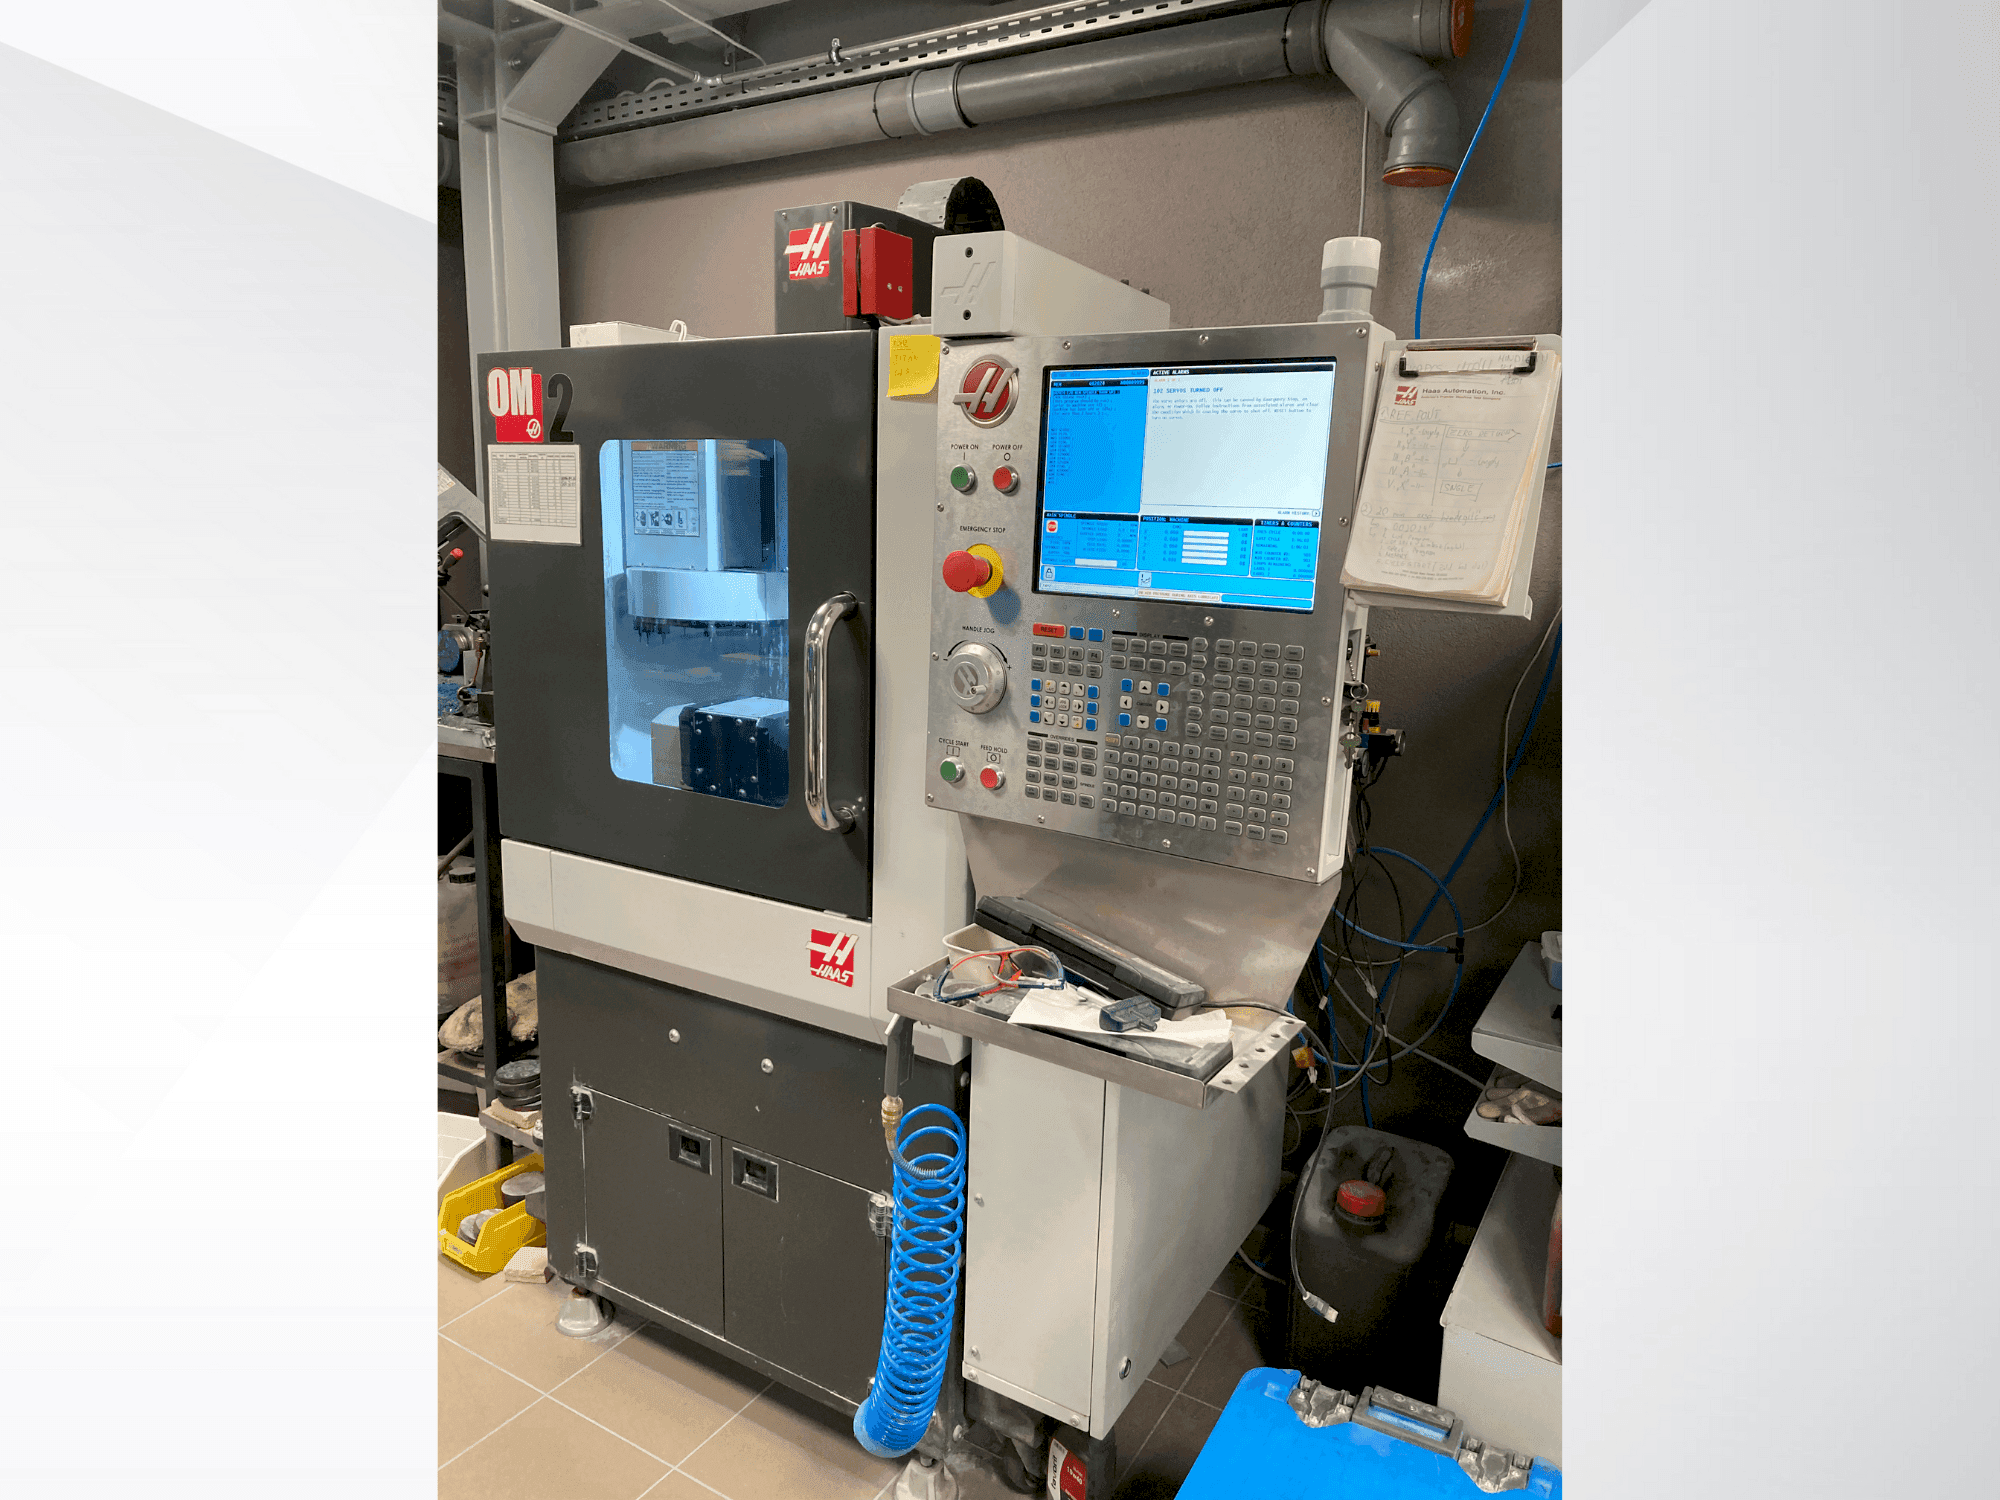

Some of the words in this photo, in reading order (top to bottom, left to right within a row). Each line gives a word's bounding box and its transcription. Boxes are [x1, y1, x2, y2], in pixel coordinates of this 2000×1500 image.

[789, 261, 829, 276] HAAS
[488, 367, 533, 416] OM
[548, 373, 574, 442] 2
[960, 525, 991, 533] EMERGENCY
[962, 625, 982, 633] HANDLE
[994, 746, 1007, 754] HOLD
[810, 964, 854, 983] HAAS
